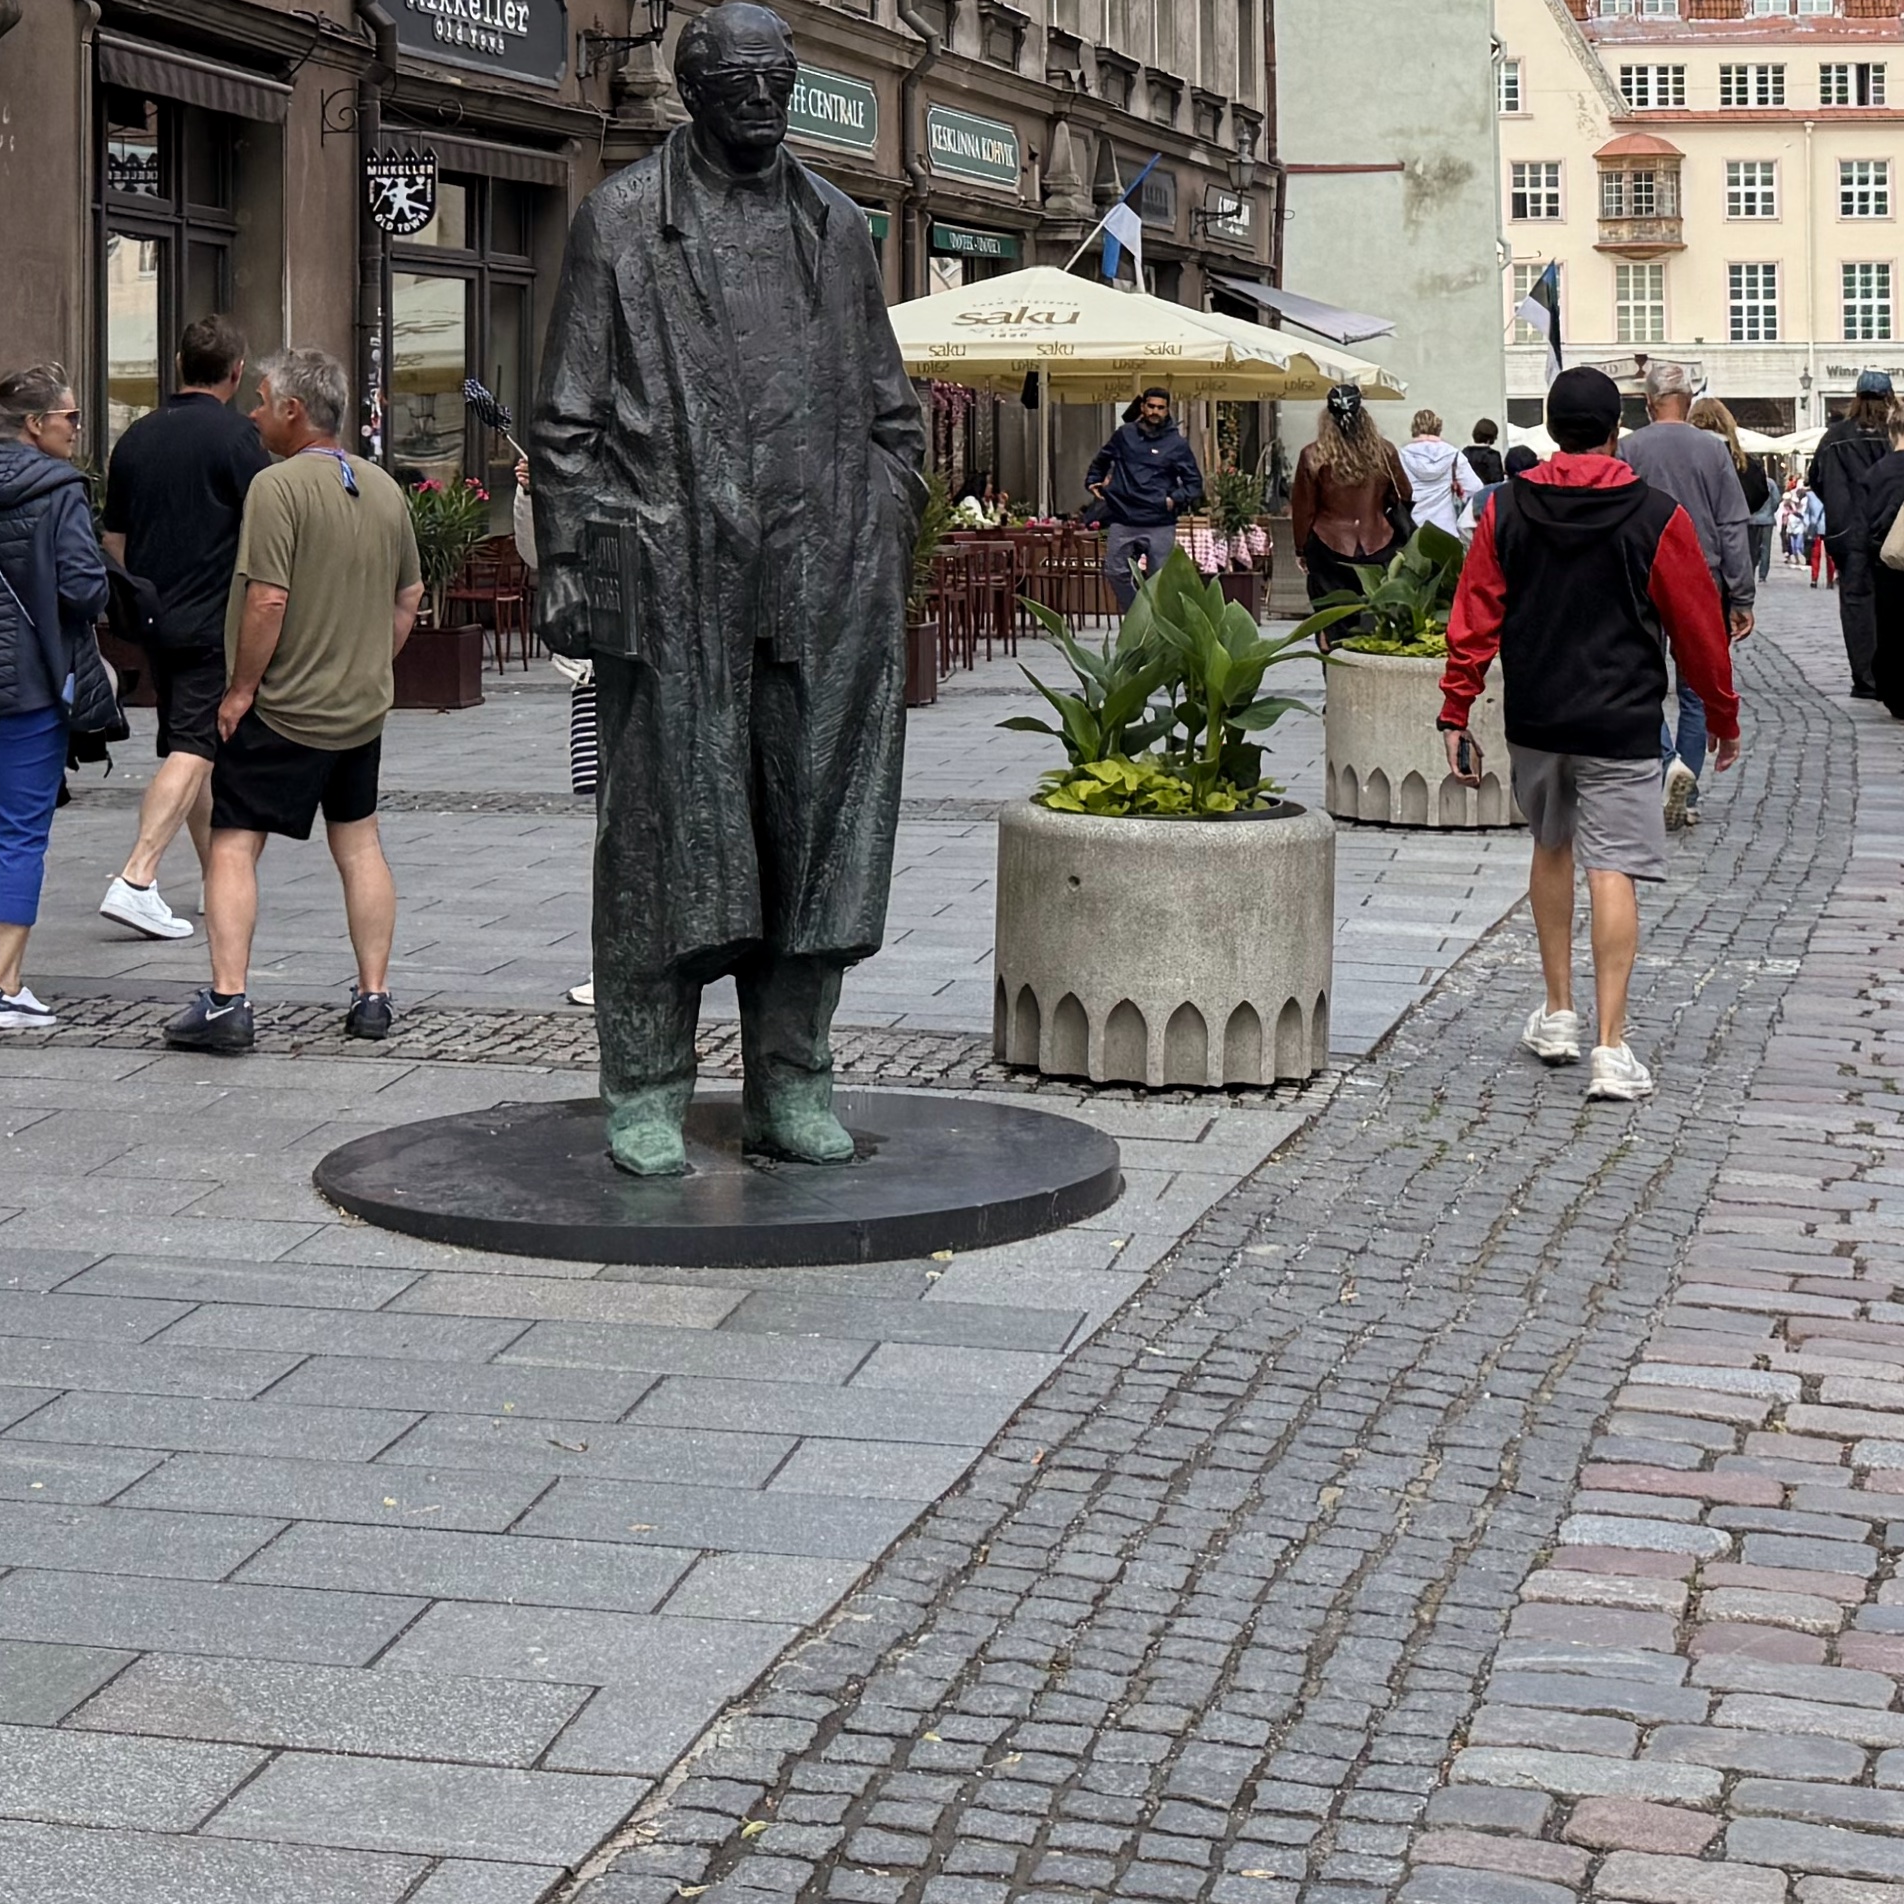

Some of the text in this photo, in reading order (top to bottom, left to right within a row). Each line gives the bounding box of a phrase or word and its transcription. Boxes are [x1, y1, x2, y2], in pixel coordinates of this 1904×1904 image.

[435, 19, 463, 43] Old
[808, 88, 865, 128] CENTRALE
[931, 123, 981, 159] KESKLINNA
[367, 165, 434, 175] MIKKELLER
[374, 212, 428, 232] OLD TOWN
[952, 306, 1080, 325] saku
[929, 342, 966, 357] saku
[1036, 341, 1075, 356] saku
[1143, 342, 1182, 356] saku
